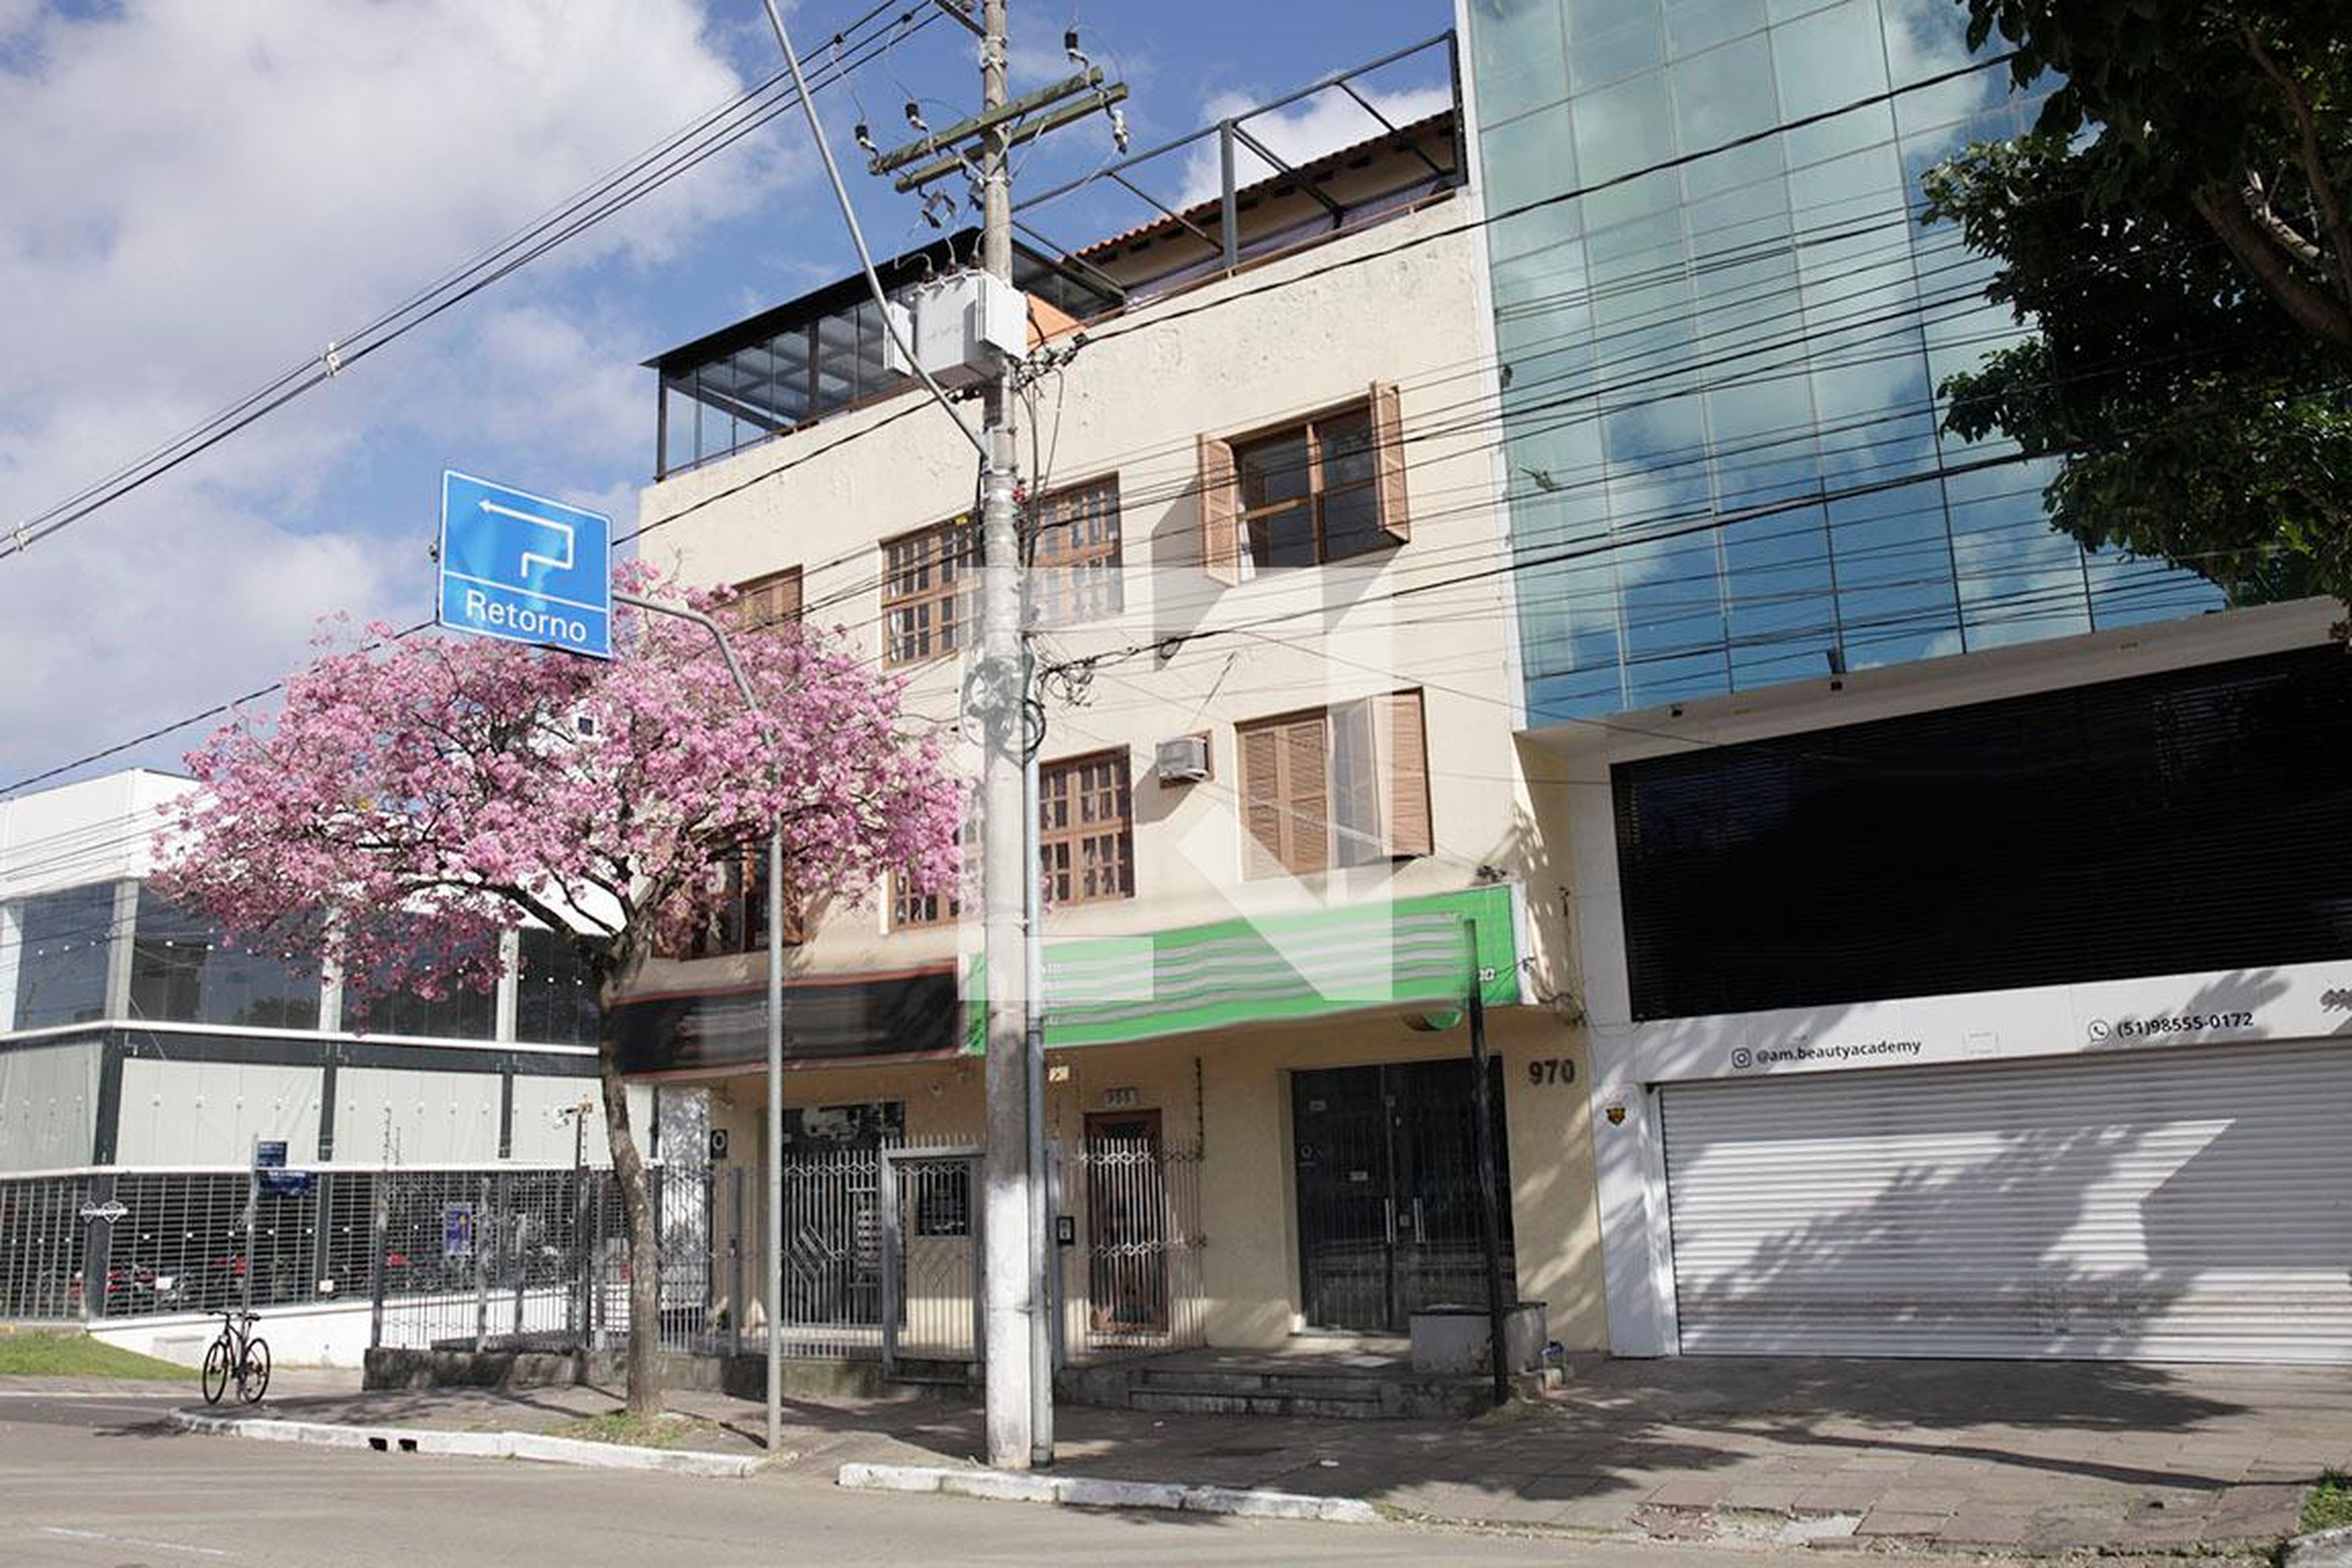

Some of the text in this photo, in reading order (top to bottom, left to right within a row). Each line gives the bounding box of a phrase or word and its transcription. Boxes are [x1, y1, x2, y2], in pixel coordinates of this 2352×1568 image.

[466, 589, 587, 642] Retorno
[2117, 1012, 2254, 1038] (51)98555-0172
[1756, 1041, 1921, 1064] @am.beautyacademy
[1529, 1059, 1575, 1085] 970
